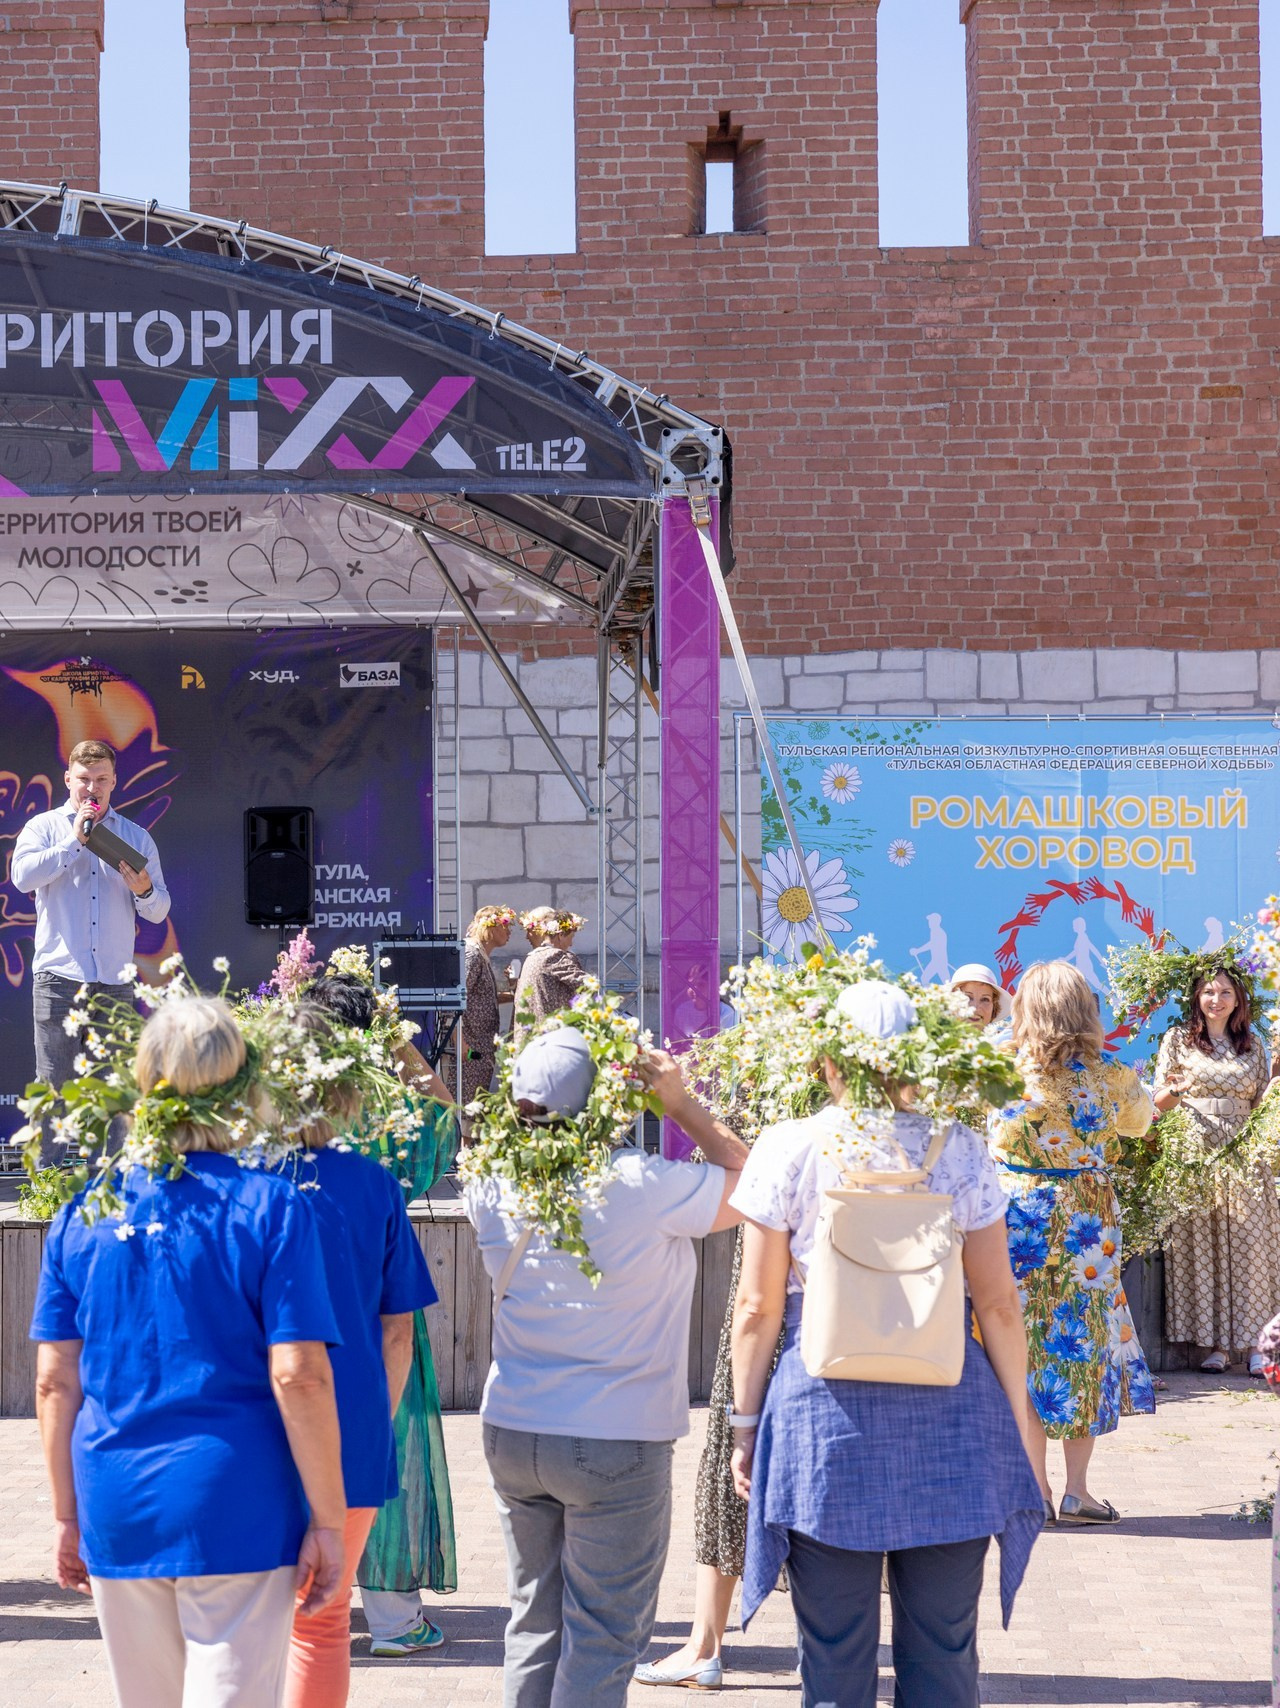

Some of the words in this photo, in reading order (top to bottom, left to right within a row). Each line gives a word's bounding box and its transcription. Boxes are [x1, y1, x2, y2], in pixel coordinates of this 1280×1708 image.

[495, 436, 587, 472] TELE2
[152, 506, 242, 533] ТВОЕЙ
[17, 544, 201, 571] МОЛОДОСТИ
[357, 669, 399, 682] БАЗА
[778, 745, 847, 756] ТУЛЬСКАЯ
[851, 745, 959, 756] РЕГИОНАЛЬНАЯ
[963, 745, 1165, 756] ФИЗКУЛЬТУРНО-СПОРТИВНАЯ
[1168, 745, 1278, 758] ОБЩЕСТВЕННАЯ
[886, 759, 961, 770] «ТУЛЬСКАЯ
[964, 759, 1046, 770] ОБЛАСТНАЯ
[1049, 759, 1132, 772] ФЕДЕРАЦИЯ
[1136, 757, 1207, 770] СЕВЕРНОЙ
[1210, 758, 1274, 772] ХОДЬБЫ»
[910, 788, 1249, 829] РОМАШКОВЫЙ
[974, 835, 1197, 875] ХОРОВОД
[314, 863, 370, 882] ТУЛА,
[261, 911, 402, 930] РЕЖНАЯ
